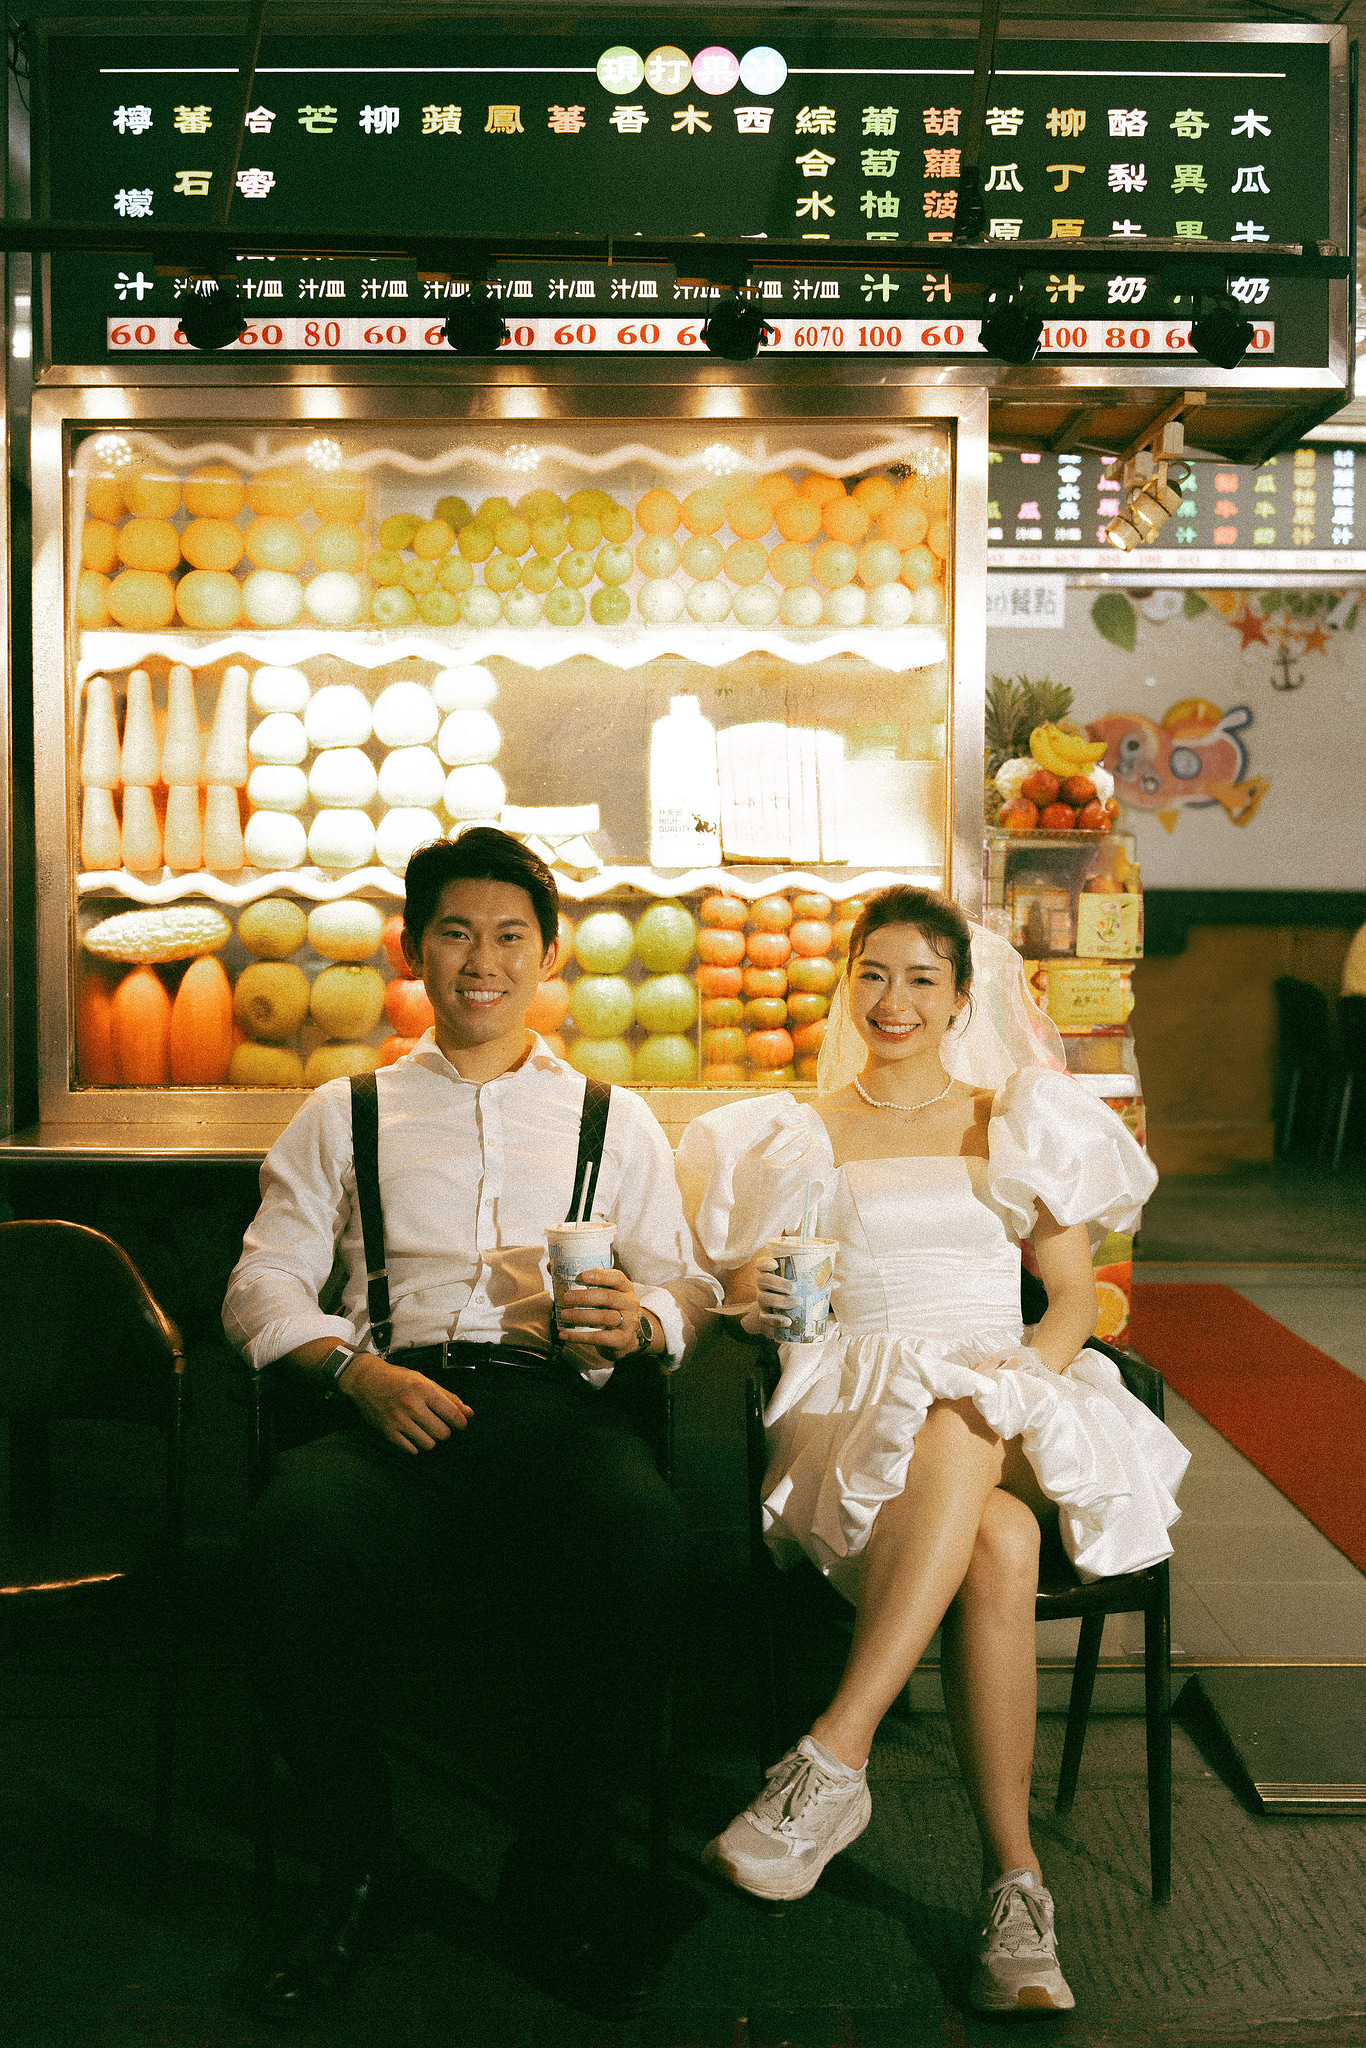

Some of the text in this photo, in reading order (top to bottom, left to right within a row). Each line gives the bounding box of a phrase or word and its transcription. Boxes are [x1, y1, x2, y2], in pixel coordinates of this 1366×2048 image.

[600, 55, 783, 84] 現打果汁
[113, 105, 154, 300] 檸檬汁
[795, 106, 836, 239] 綜合水
[111, 324, 155, 345] 60
[238, 324, 283, 345] 60
[304, 321, 340, 346] 80
[364, 325, 406, 345] 60
[554, 324, 597, 345] 60
[617, 324, 660, 345] 60
[858, 326, 902, 347] 100
[921, 325, 964, 346] 60
[1042, 327, 1087, 348] 100
[1105, 328, 1150, 348] 80
